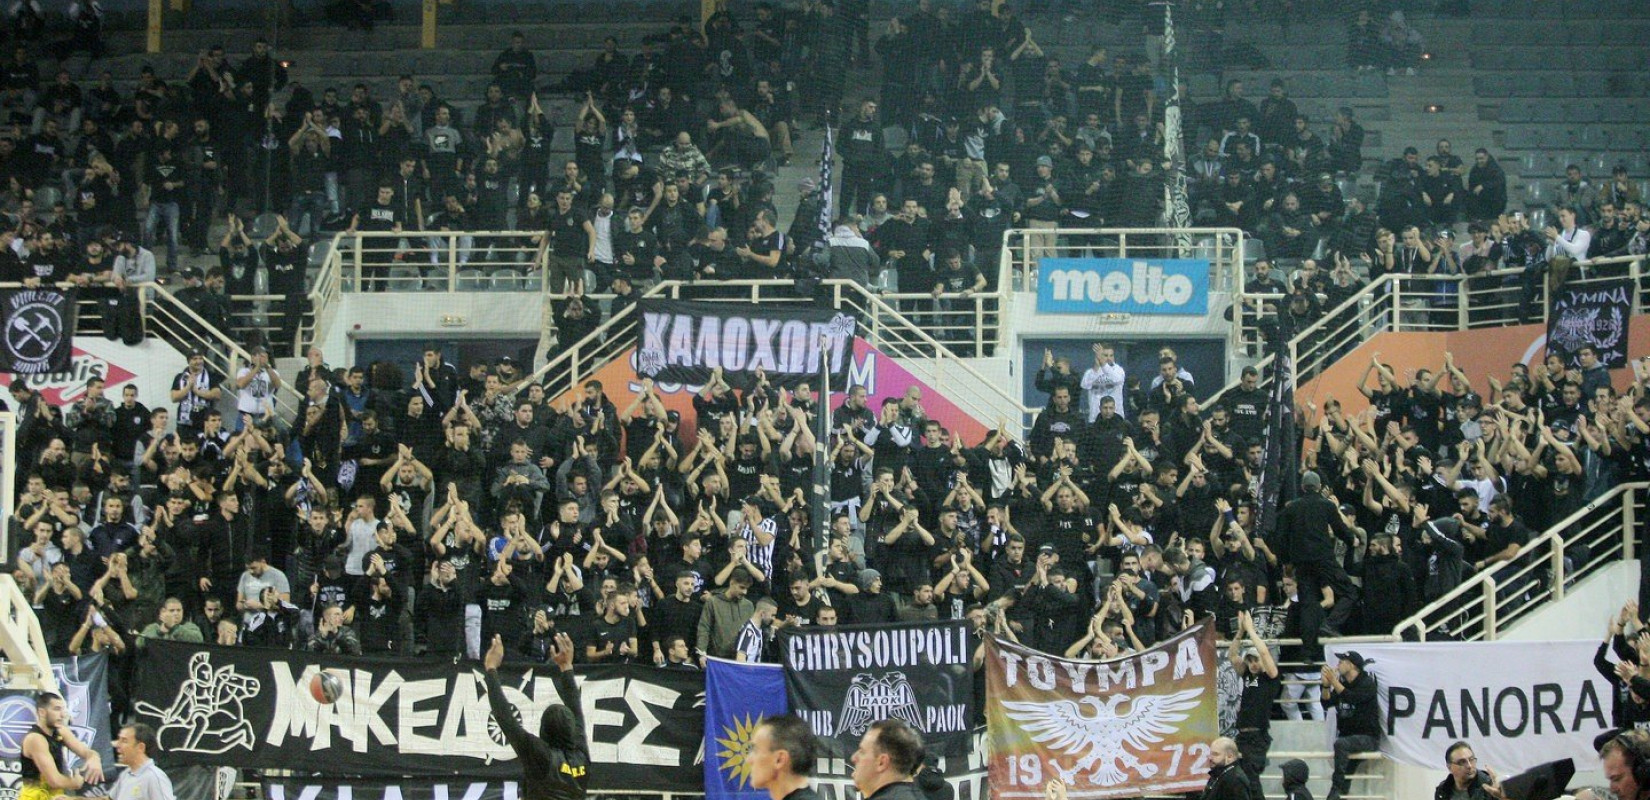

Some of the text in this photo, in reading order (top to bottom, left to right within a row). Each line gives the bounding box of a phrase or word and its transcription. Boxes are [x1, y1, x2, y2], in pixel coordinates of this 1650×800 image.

[1049, 261, 1193, 306] molto
[643, 311, 849, 375] ΚΑΛΟΧΩΡΙ
[789, 626, 967, 672] CHRYSOUPOLI
[796, 704, 967, 737] UB PAOK
[1005, 743, 1211, 785] 19 72
